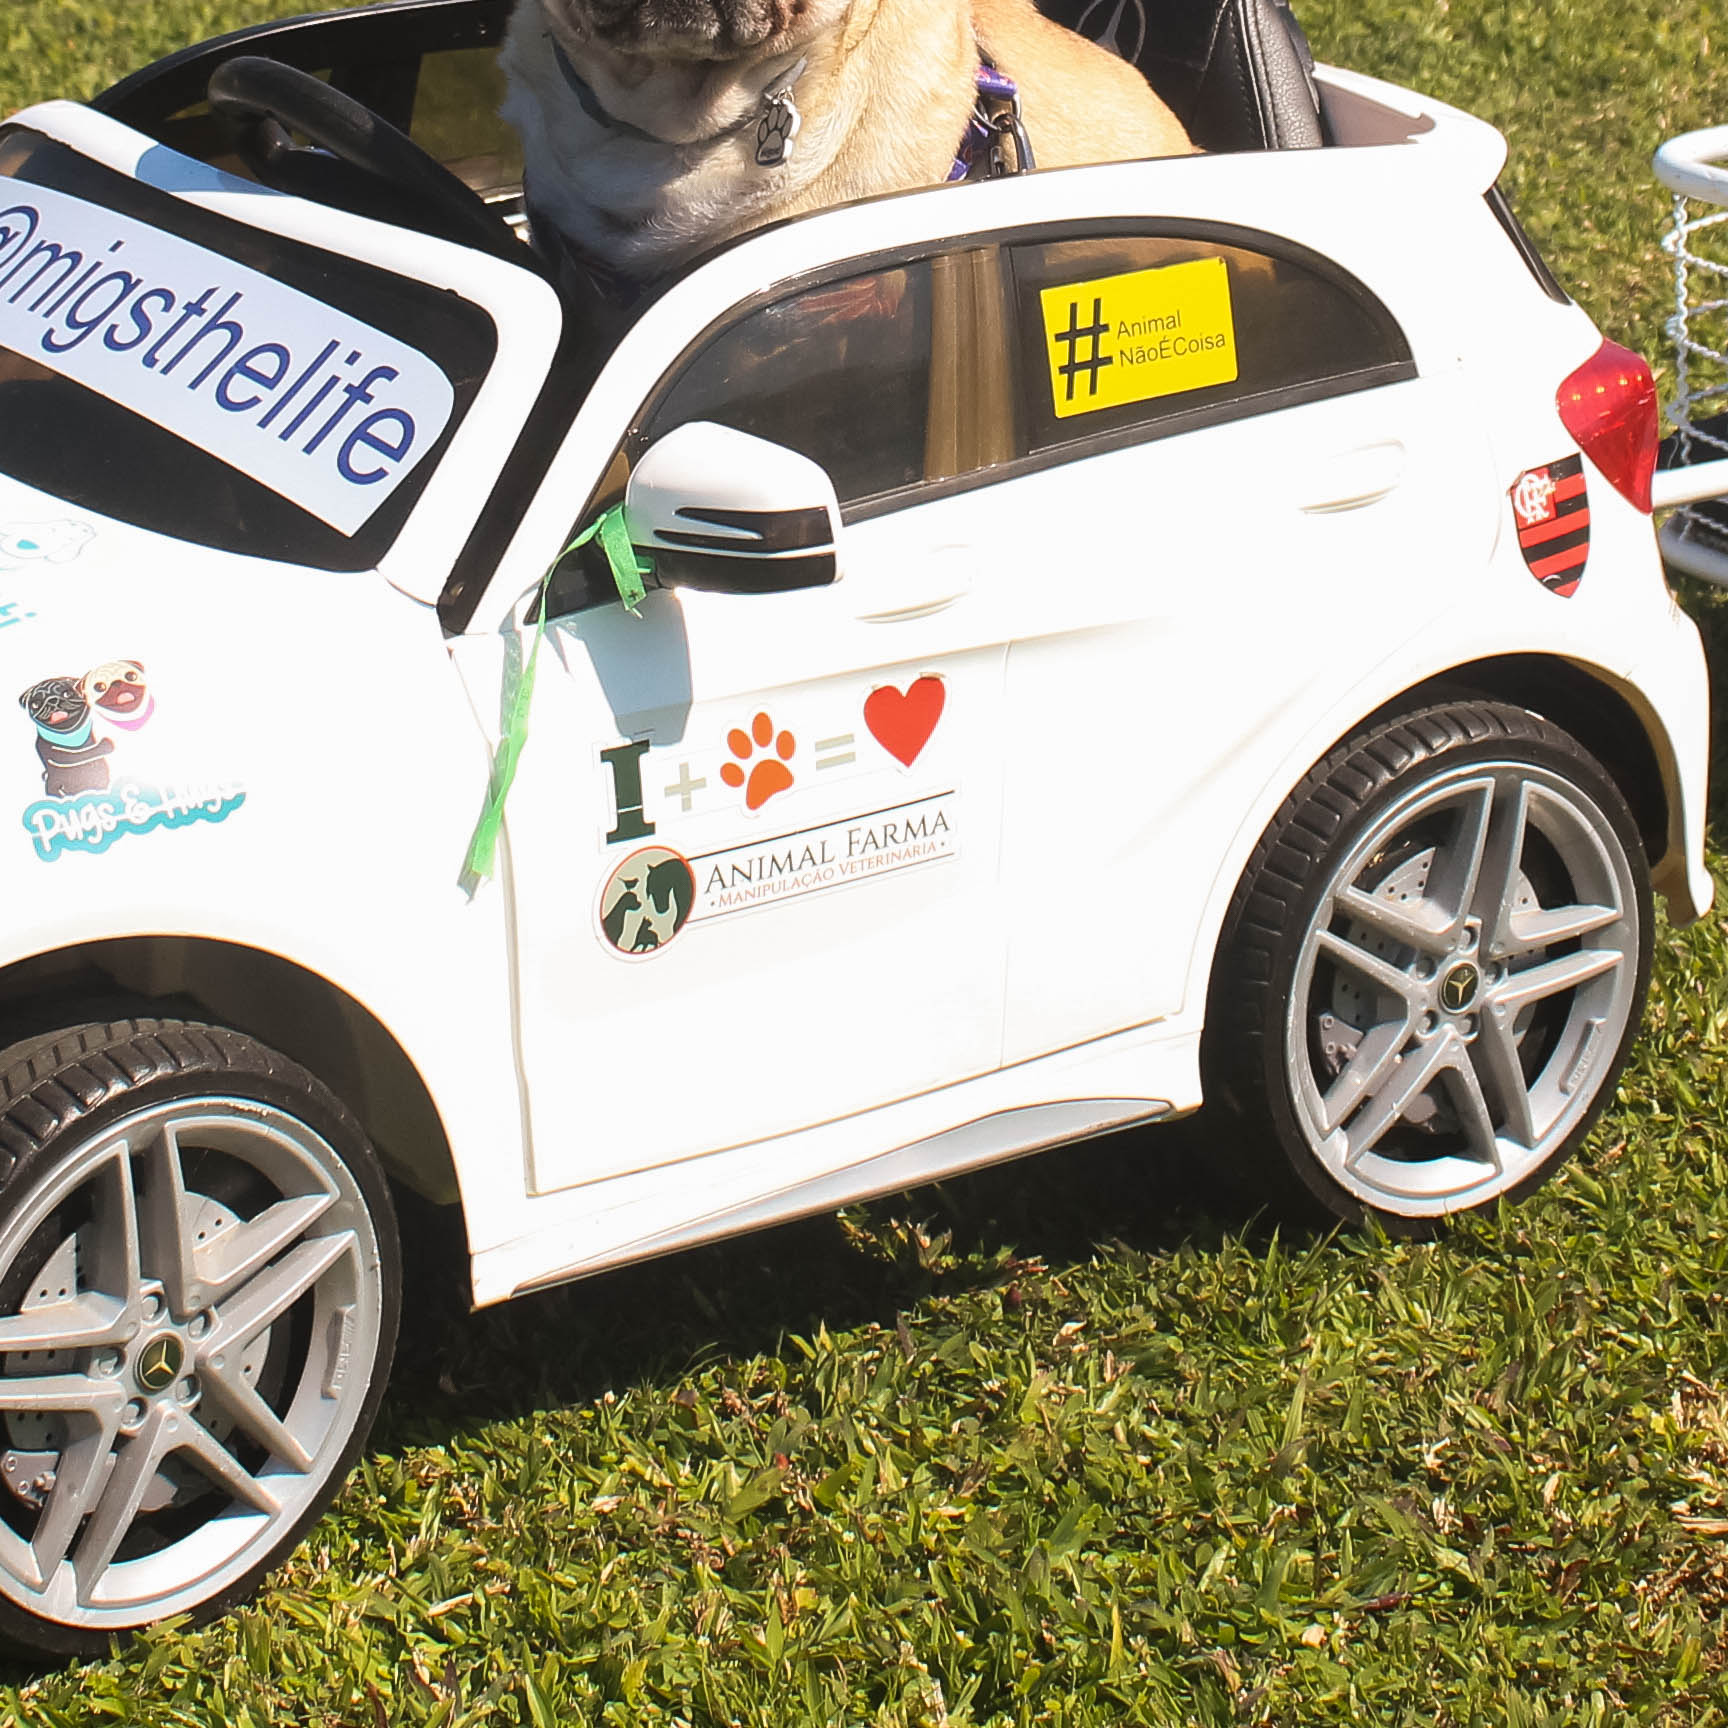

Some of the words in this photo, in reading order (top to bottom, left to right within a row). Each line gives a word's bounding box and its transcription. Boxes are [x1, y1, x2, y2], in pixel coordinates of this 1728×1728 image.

[1116, 309, 1182, 340] Animal
[1119, 332, 1227, 368] NãoÉCoisa
[32, 802, 118, 853] Pugs
[704, 840, 836, 895] ANIMAL
[846, 809, 951, 859] FARMA
[717, 864, 836, 909] MANIPULAÇÃO
